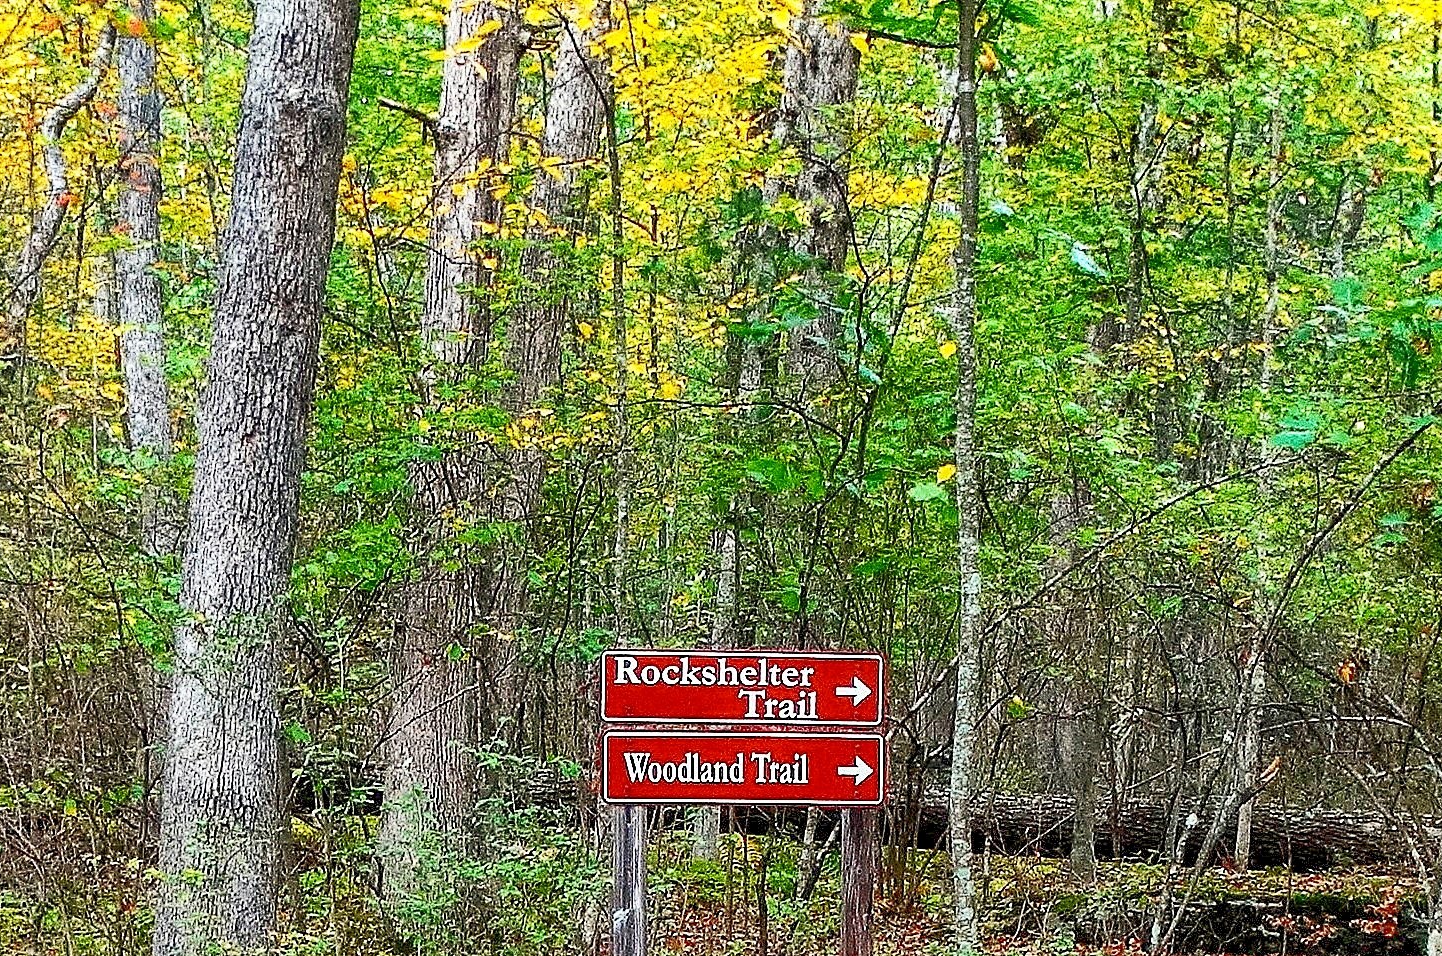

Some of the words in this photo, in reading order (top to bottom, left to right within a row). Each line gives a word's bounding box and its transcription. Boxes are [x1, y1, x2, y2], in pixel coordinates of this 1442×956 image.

[614, 656, 814, 687] Rockshelter
[738, 689, 819, 719] Trail
[623, 752, 744, 783] Woodland
[751, 752, 809, 784] Trail
